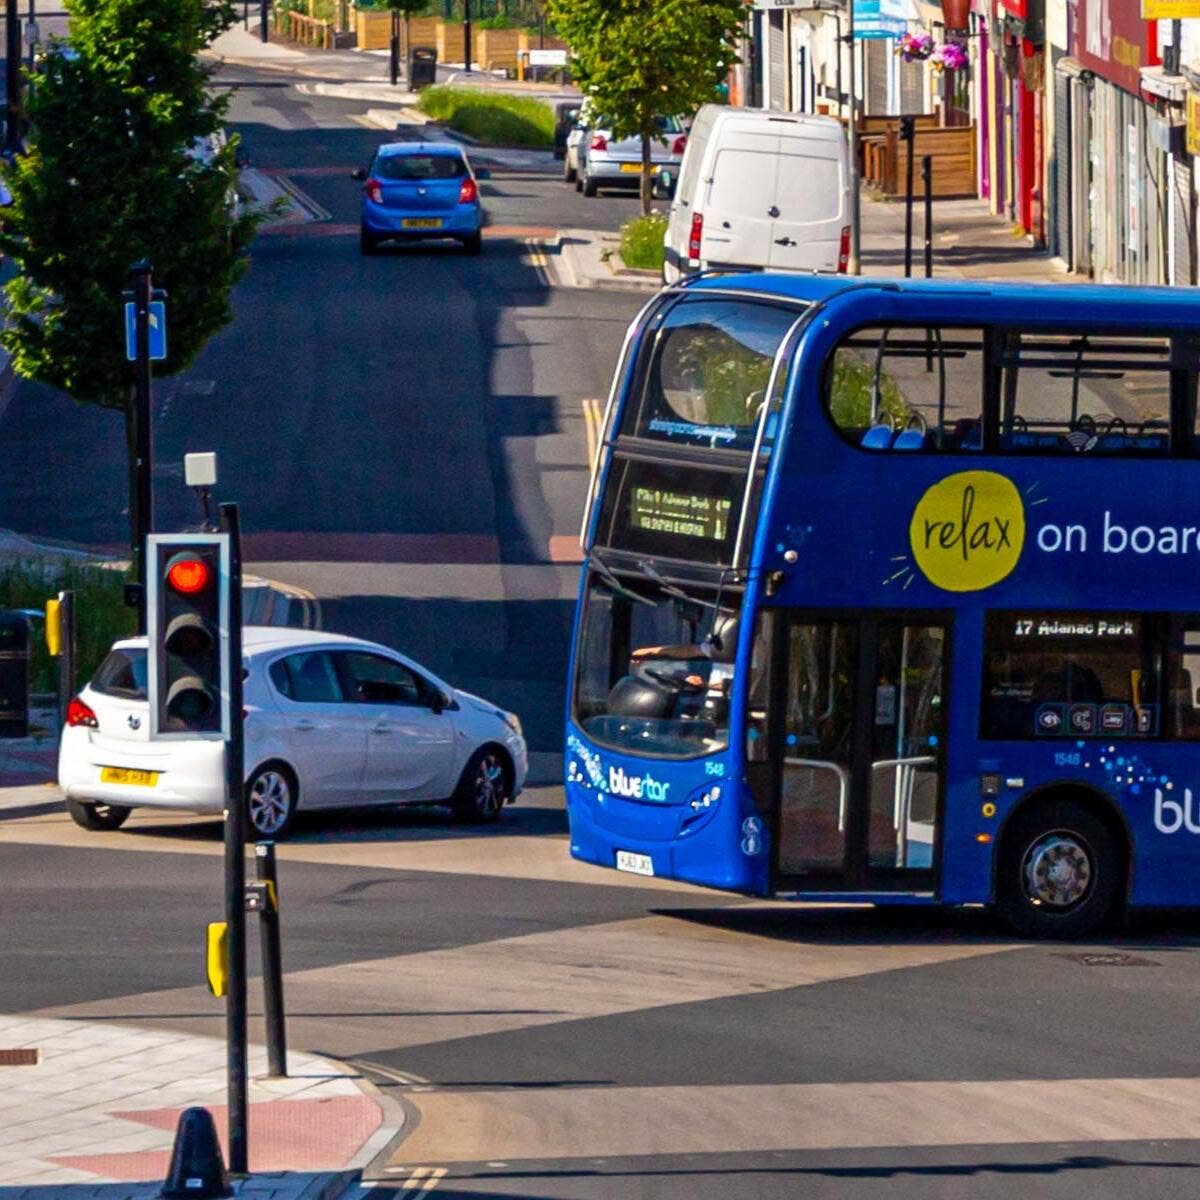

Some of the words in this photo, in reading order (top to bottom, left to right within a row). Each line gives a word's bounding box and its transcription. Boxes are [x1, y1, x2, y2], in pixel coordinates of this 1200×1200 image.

[923, 483, 1011, 562] relax
[1037, 523, 1087, 552] on
[1014, 619, 1034, 636] 17
[1097, 620, 1134, 637] Park
[1054, 752, 1081, 766] 1548
[608, 764, 671, 802] bluestar
